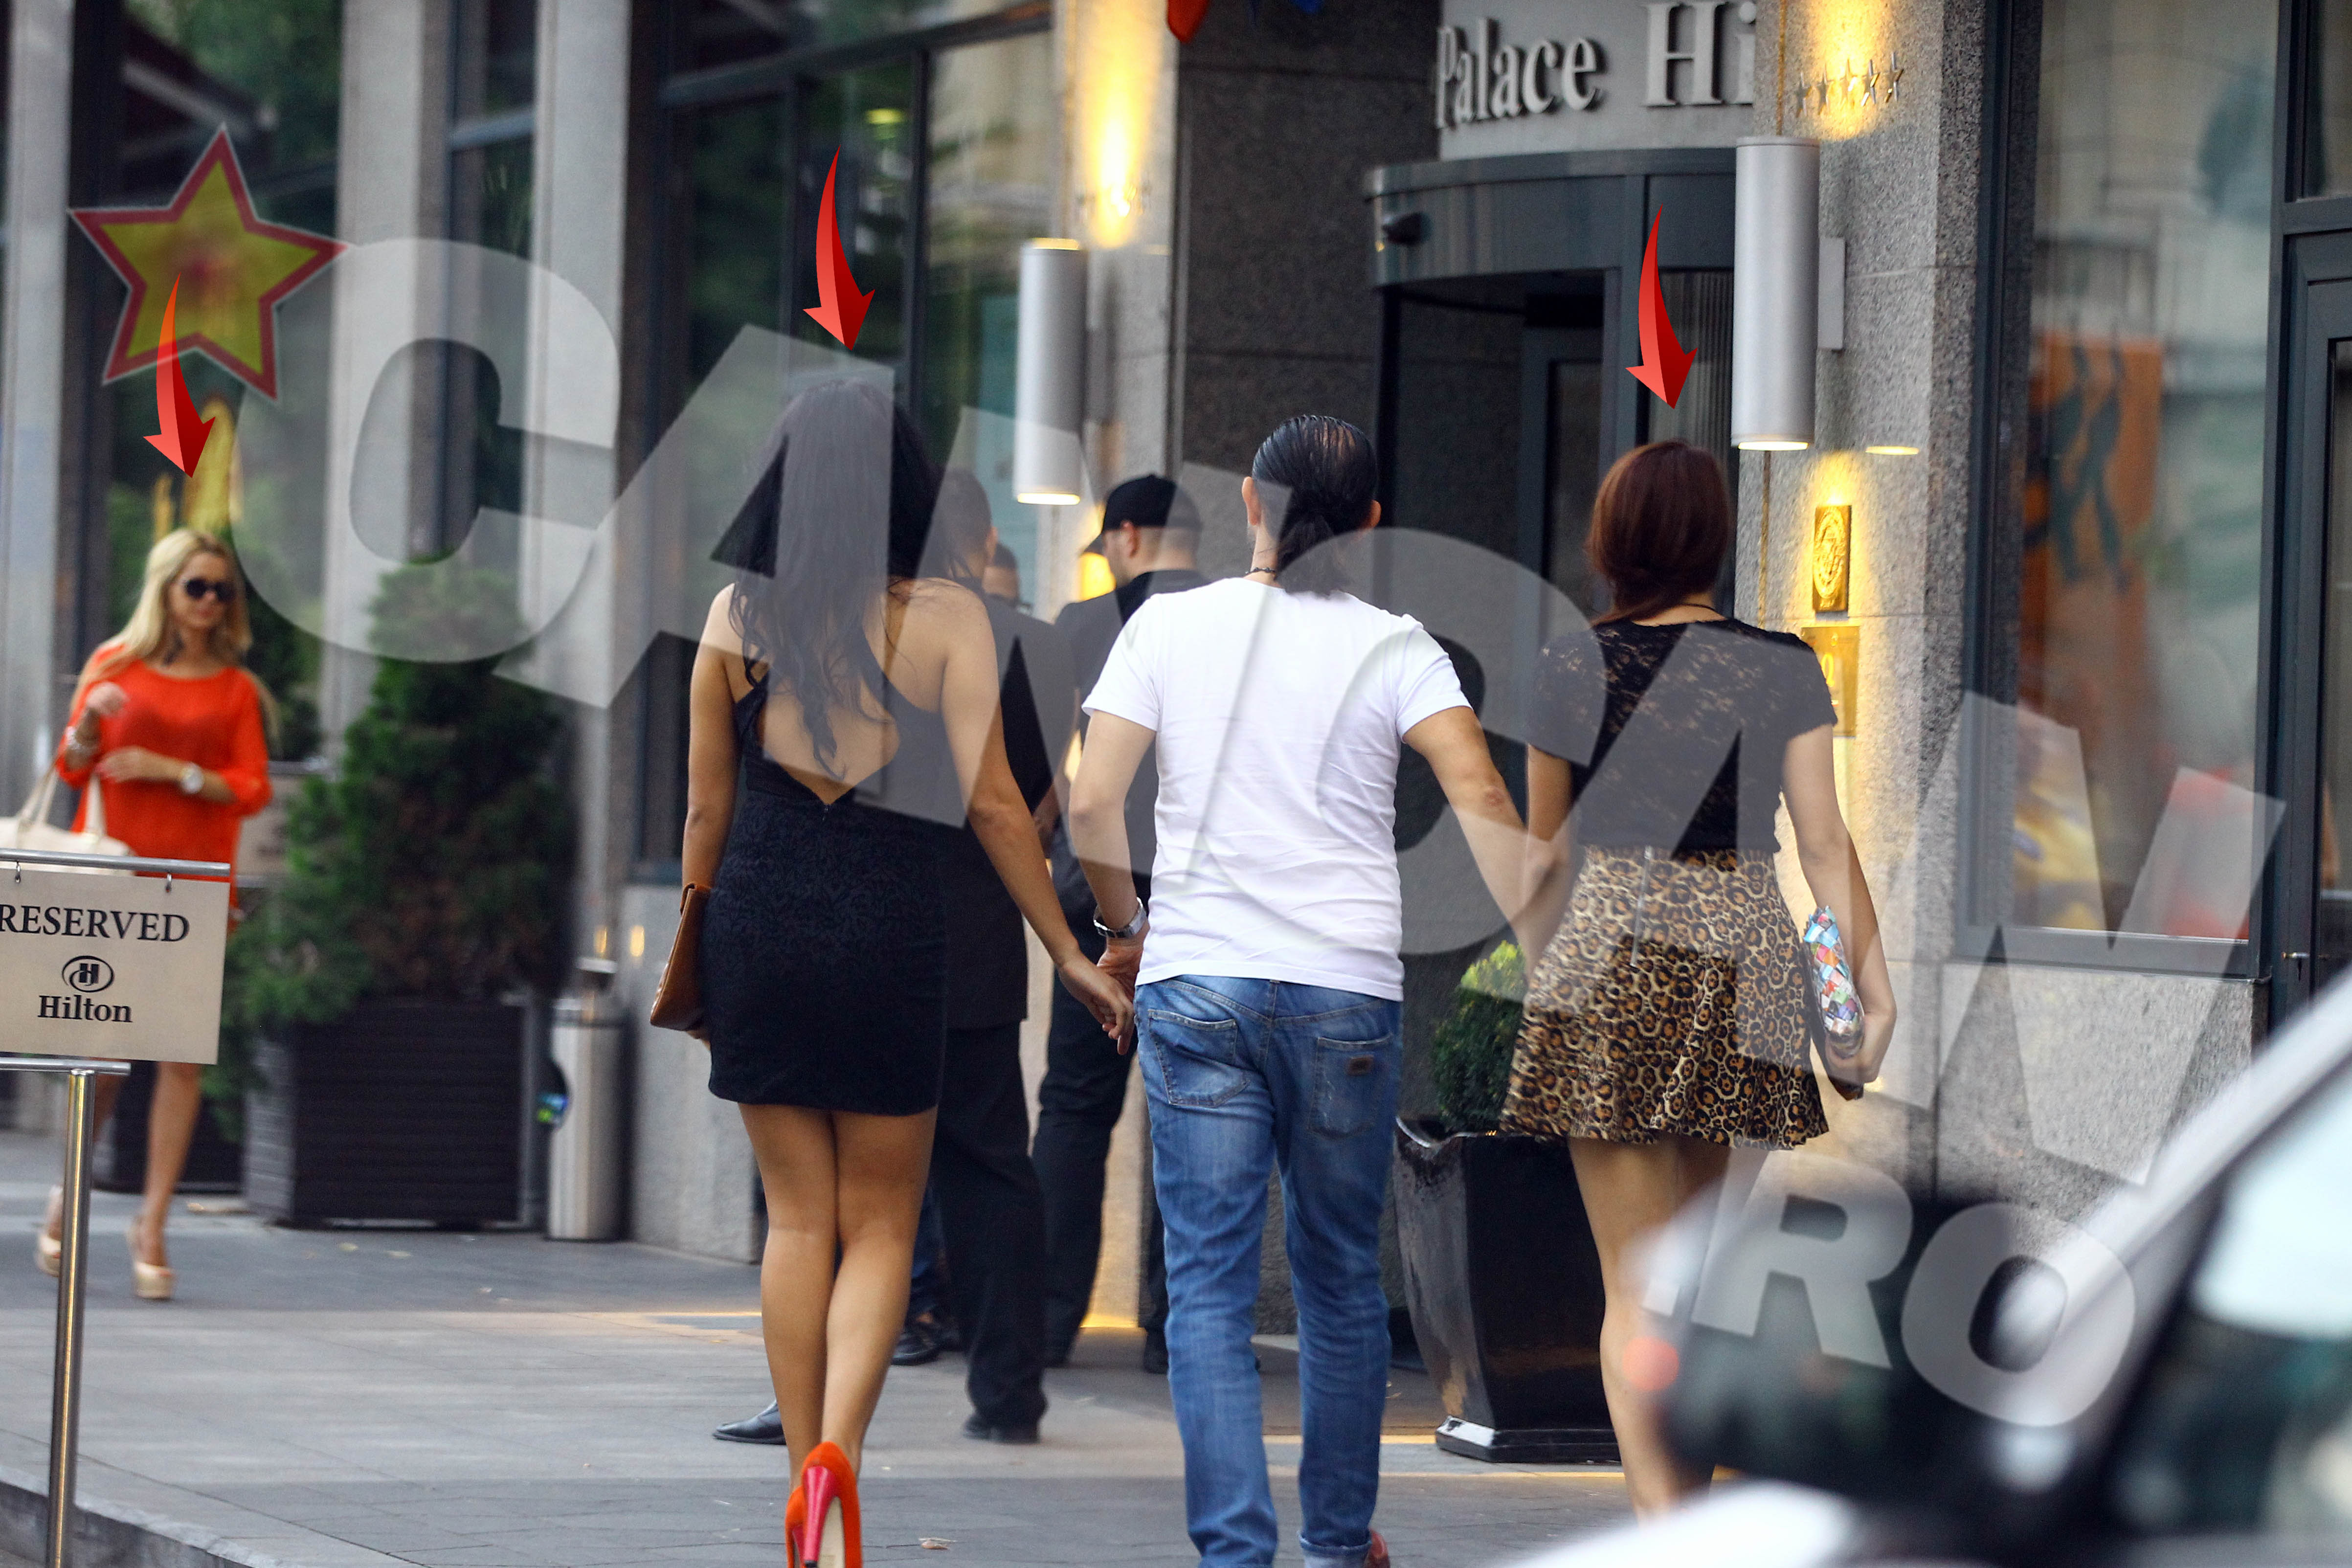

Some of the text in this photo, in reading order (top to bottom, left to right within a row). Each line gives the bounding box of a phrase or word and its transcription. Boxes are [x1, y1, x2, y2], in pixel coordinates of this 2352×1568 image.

[1436, 18, 1603, 129] Palace
[0, 904, 190, 942] RESERVED
[37, 994, 133, 1023] Hilton
